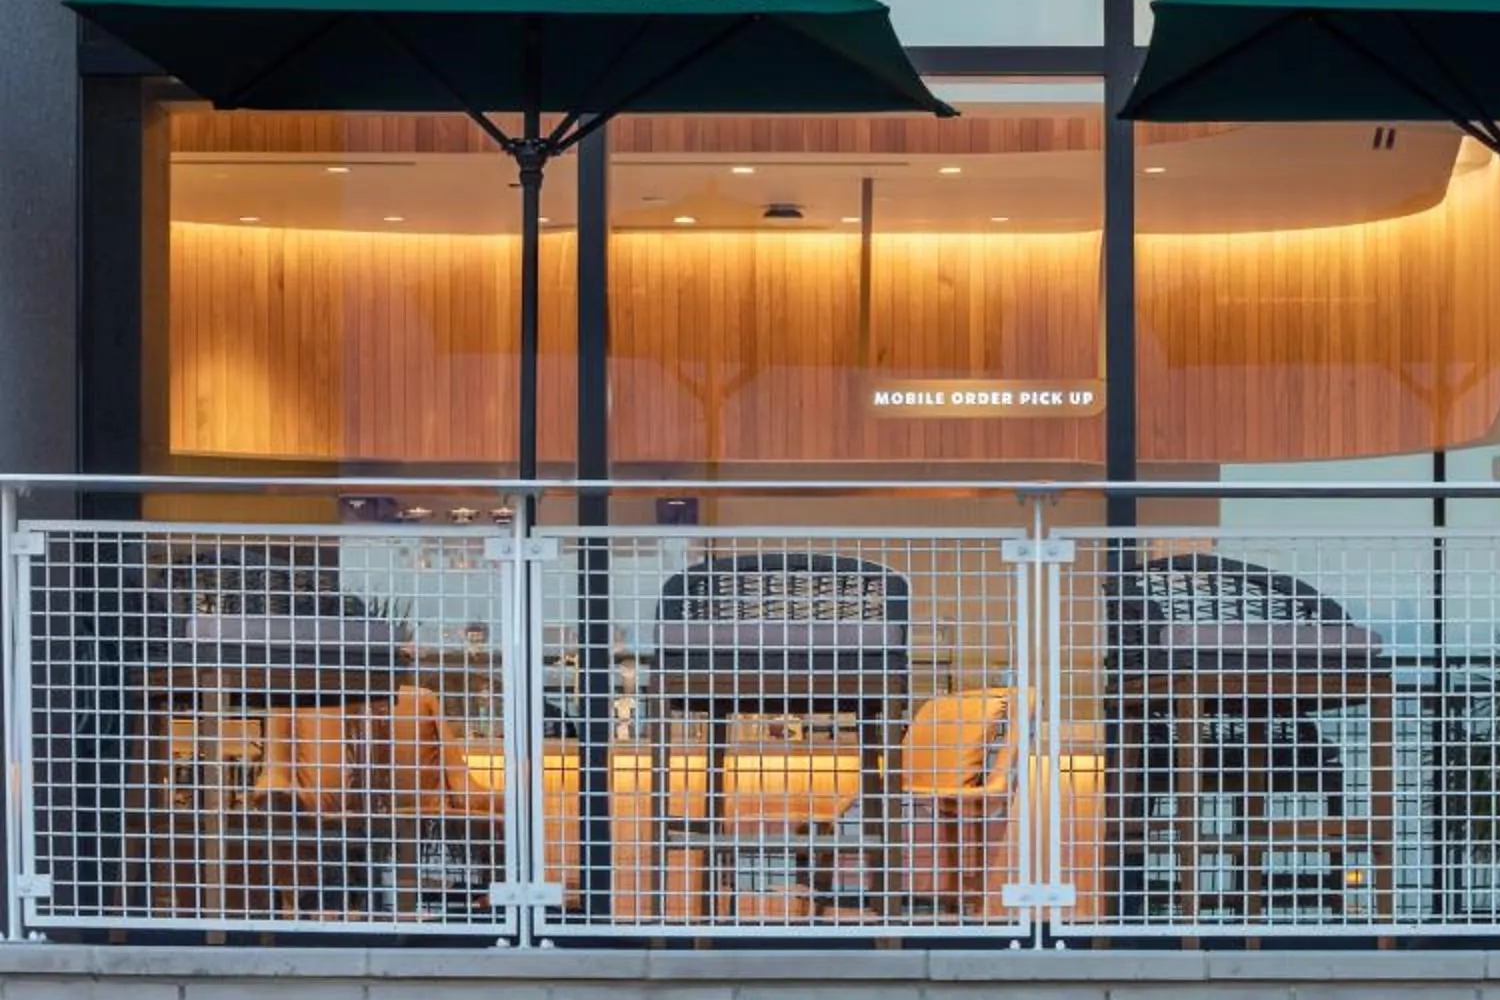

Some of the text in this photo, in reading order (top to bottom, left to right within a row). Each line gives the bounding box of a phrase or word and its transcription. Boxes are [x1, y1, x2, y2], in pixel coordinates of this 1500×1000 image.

[874, 391, 1093, 405] MOBILE ORDER PICK UP
